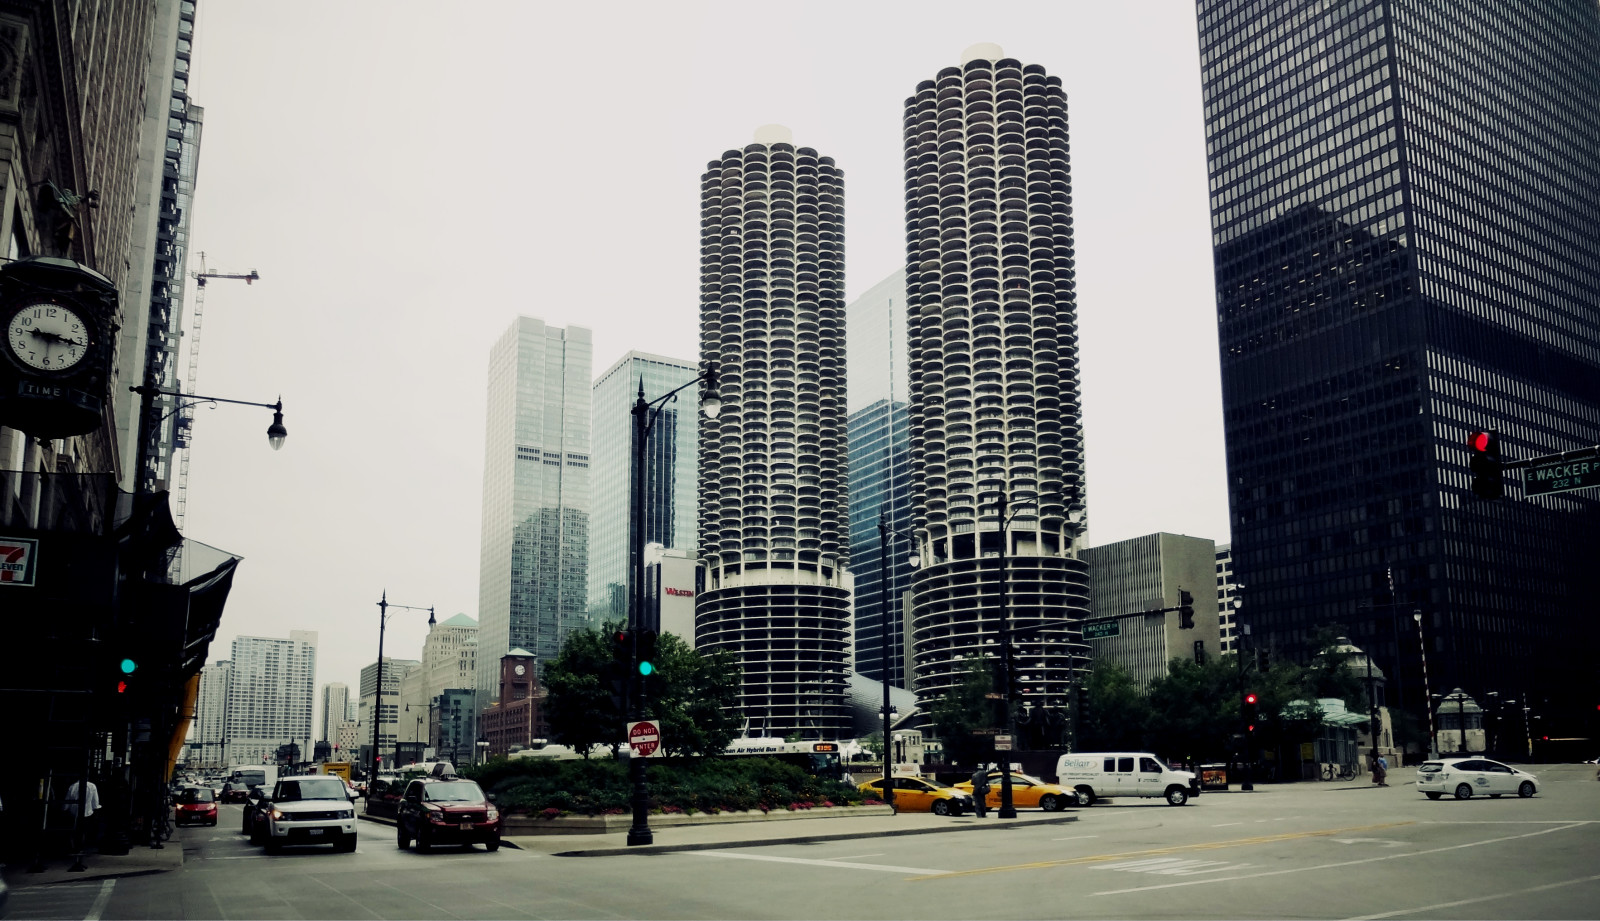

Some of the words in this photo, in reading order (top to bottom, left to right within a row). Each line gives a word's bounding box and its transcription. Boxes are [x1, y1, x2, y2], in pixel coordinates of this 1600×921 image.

[33, 309, 41, 318] 11
[46, 308, 57, 318] 12
[21, 317, 32, 326] 10
[64, 314, 68, 322] 1
[16, 328, 23, 336] 9
[71, 324, 78, 333] 2
[18, 341, 26, 349] 8
[76, 336, 82, 345] 3
[28, 351, 36, 360] 7
[68, 348, 76, 358] 4
[42, 356, 50, 366] 6
[58, 354, 64, 365] 5
[28, 385, 60, 396] TIME
[1528, 472, 1533, 481] E
[1536, 462, 1589, 481] WACKER
[1552, 479, 1569, 489] 232
[1574, 477, 1581, 485] N
[1088, 624, 1111, 632] WACKER
[1064, 760, 1090, 768] Bellair
